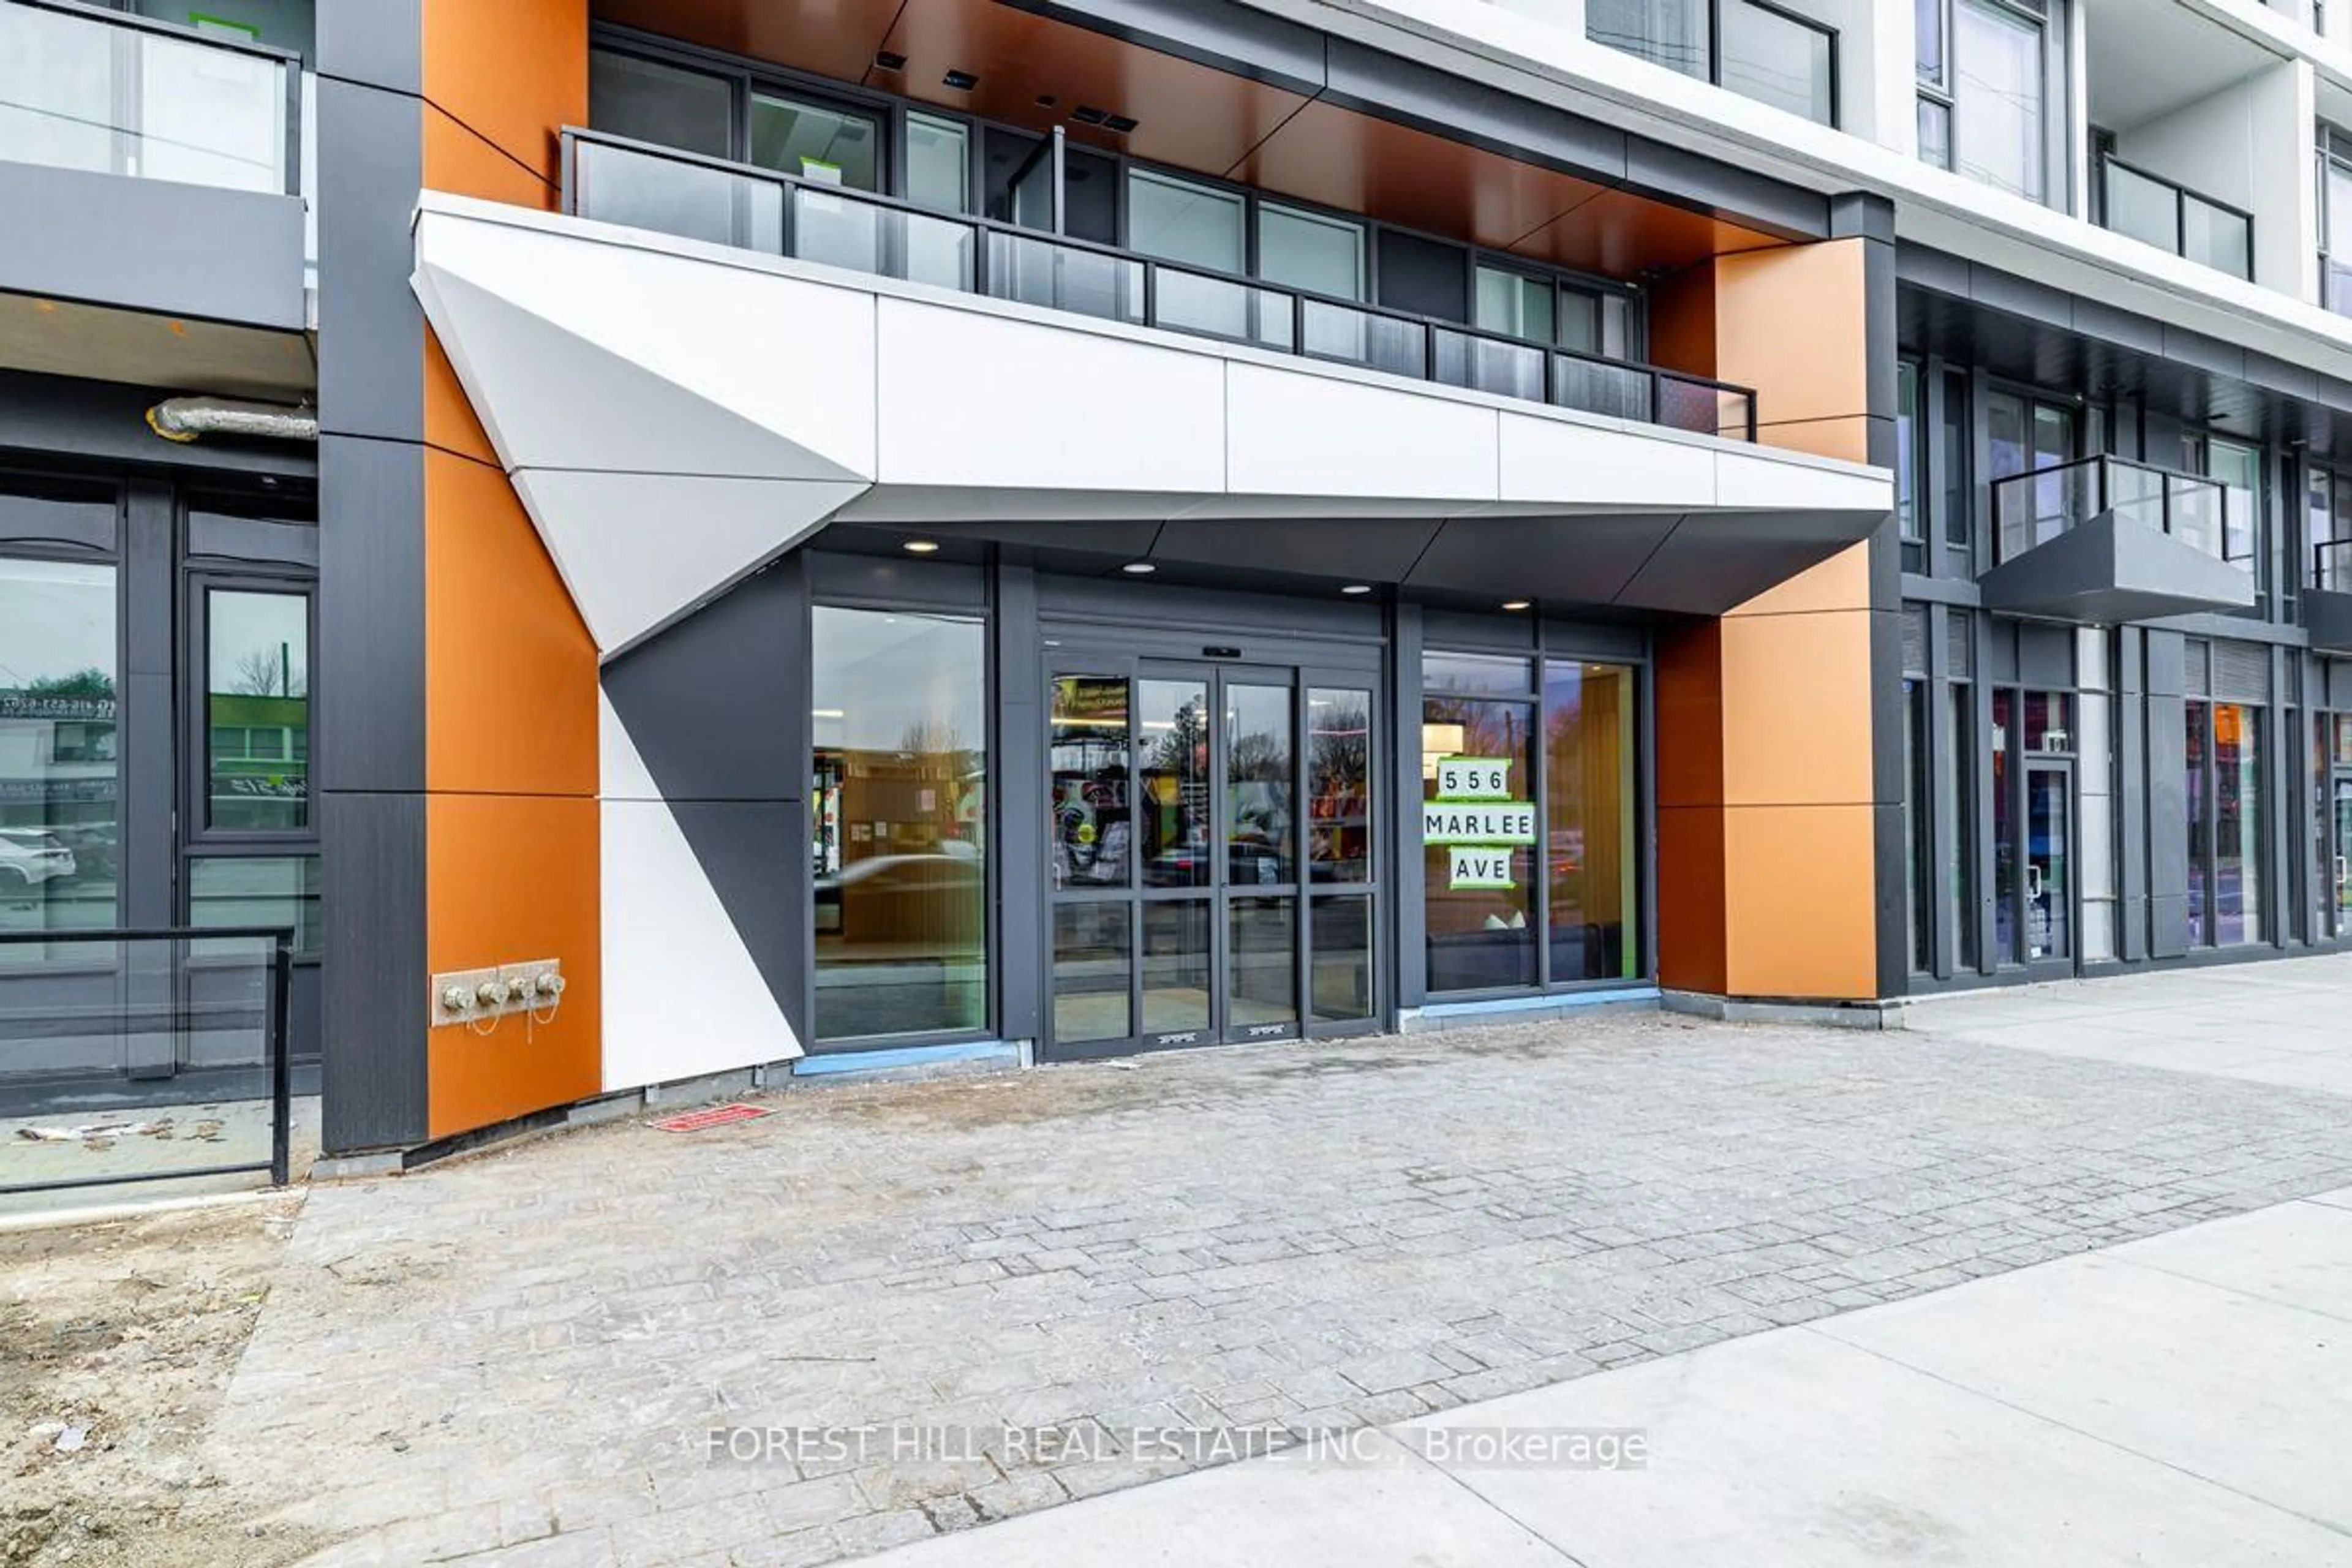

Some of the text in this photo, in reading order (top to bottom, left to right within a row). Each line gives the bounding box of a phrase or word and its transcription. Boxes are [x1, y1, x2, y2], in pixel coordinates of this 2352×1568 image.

[1446, 771, 1501, 790] 556
[1426, 815, 1529, 834] MARLEE
[1456, 859, 1504, 879] AVE
